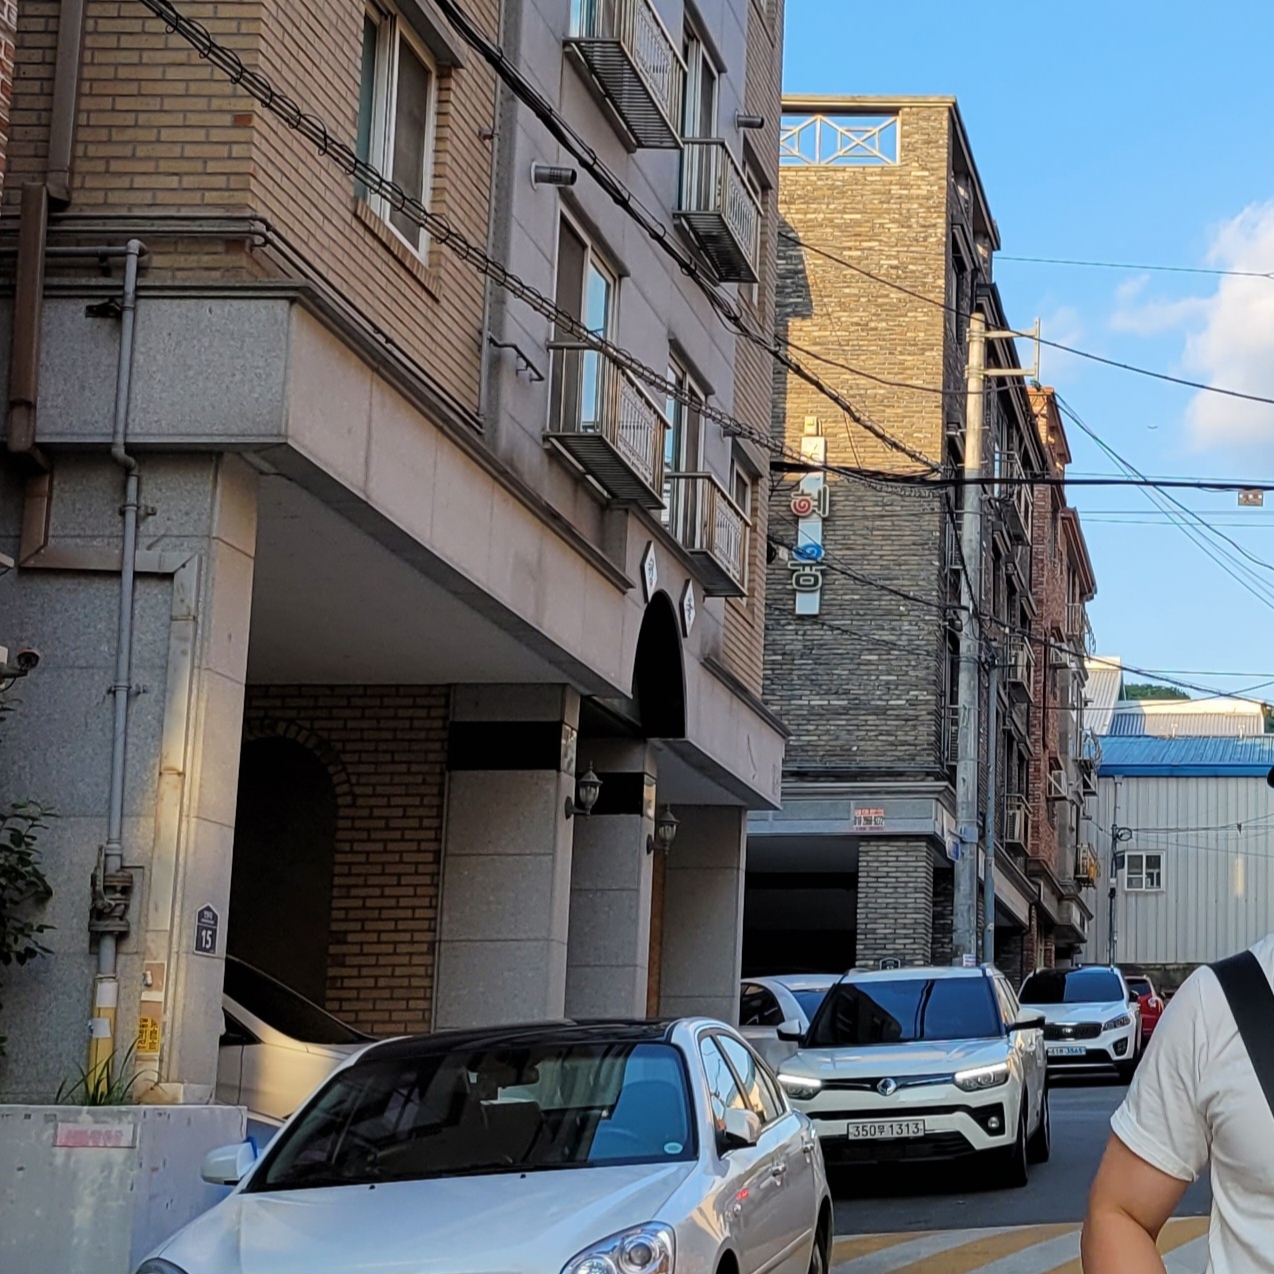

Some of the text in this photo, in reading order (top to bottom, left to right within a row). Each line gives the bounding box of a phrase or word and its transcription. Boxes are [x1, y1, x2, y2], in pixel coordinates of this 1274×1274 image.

[201, 929, 212, 949] 15
[853, 1122, 920, 1138] 350무 1313
